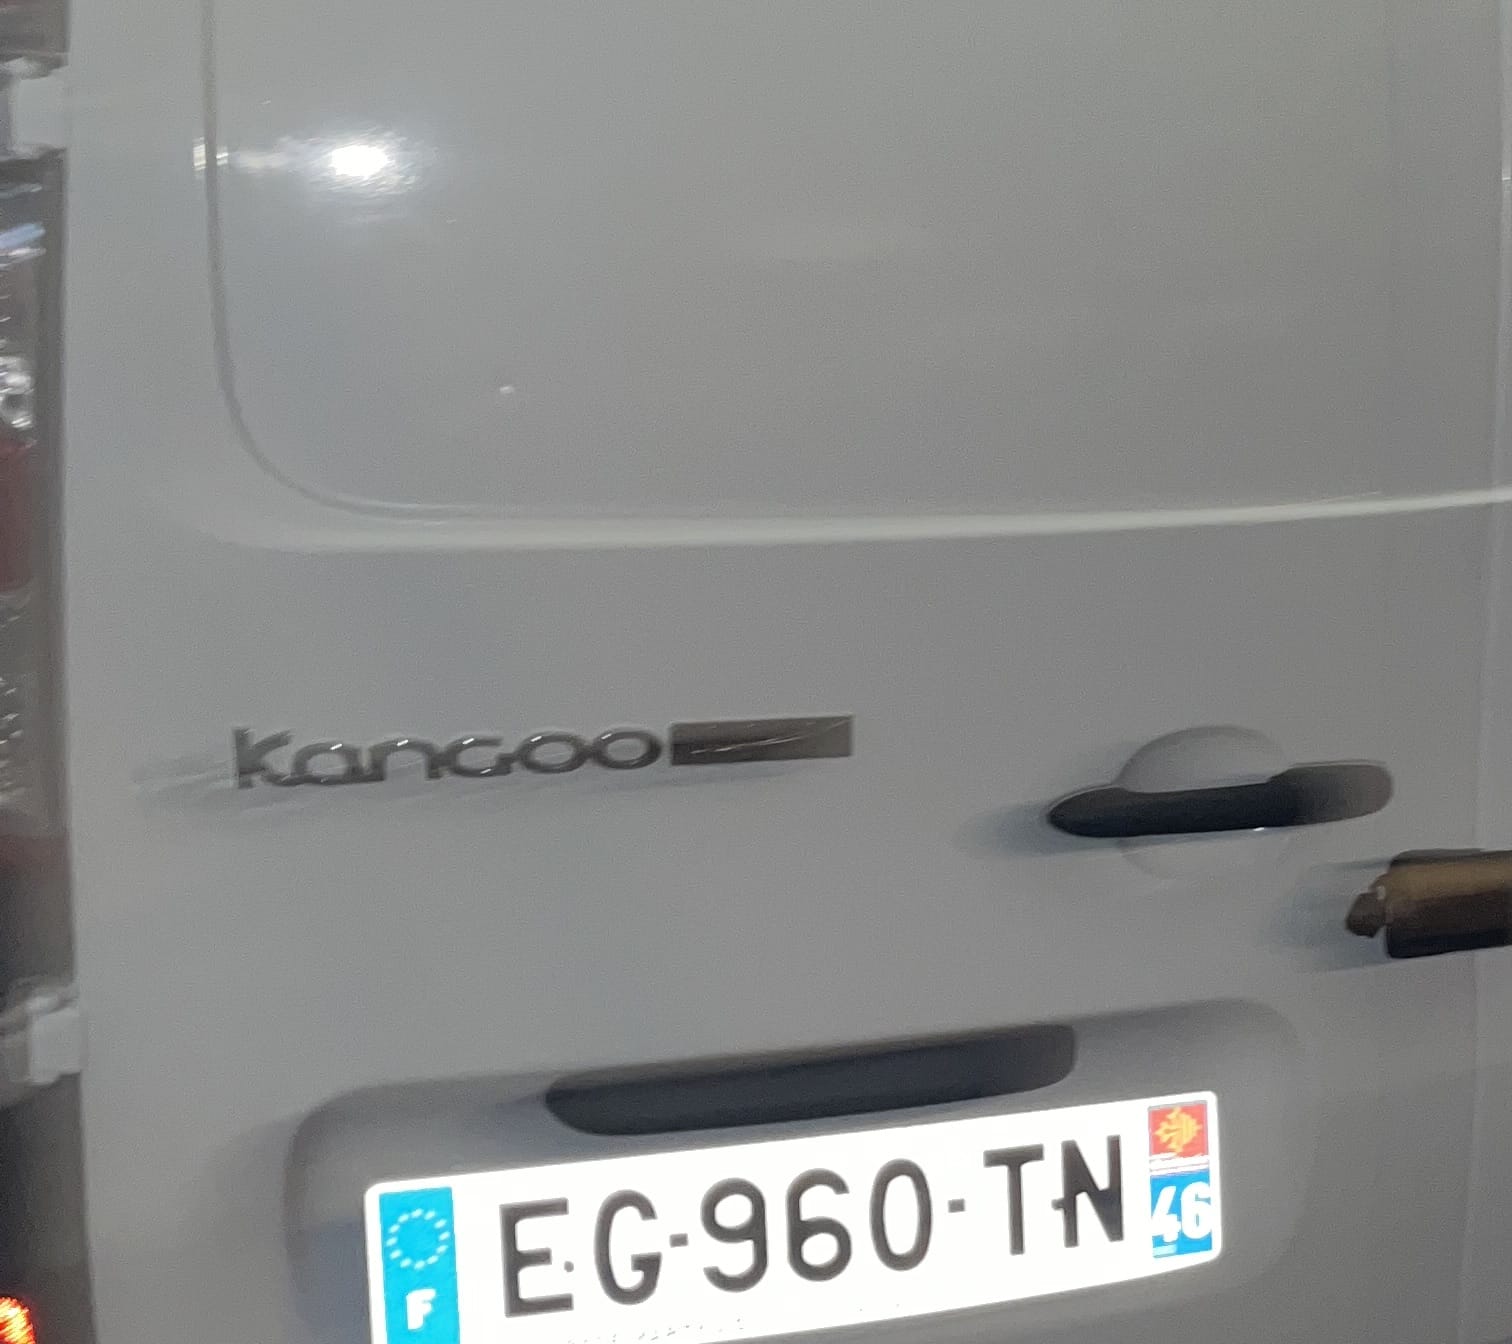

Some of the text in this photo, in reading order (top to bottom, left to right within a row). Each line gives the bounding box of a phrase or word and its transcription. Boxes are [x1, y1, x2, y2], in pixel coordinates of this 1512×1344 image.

[232, 726, 662, 789] Kangoo
[498, 1134, 1126, 1318] EG-960-TN
[1150, 1180, 1212, 1244] 46
[404, 1290, 436, 1332] F
